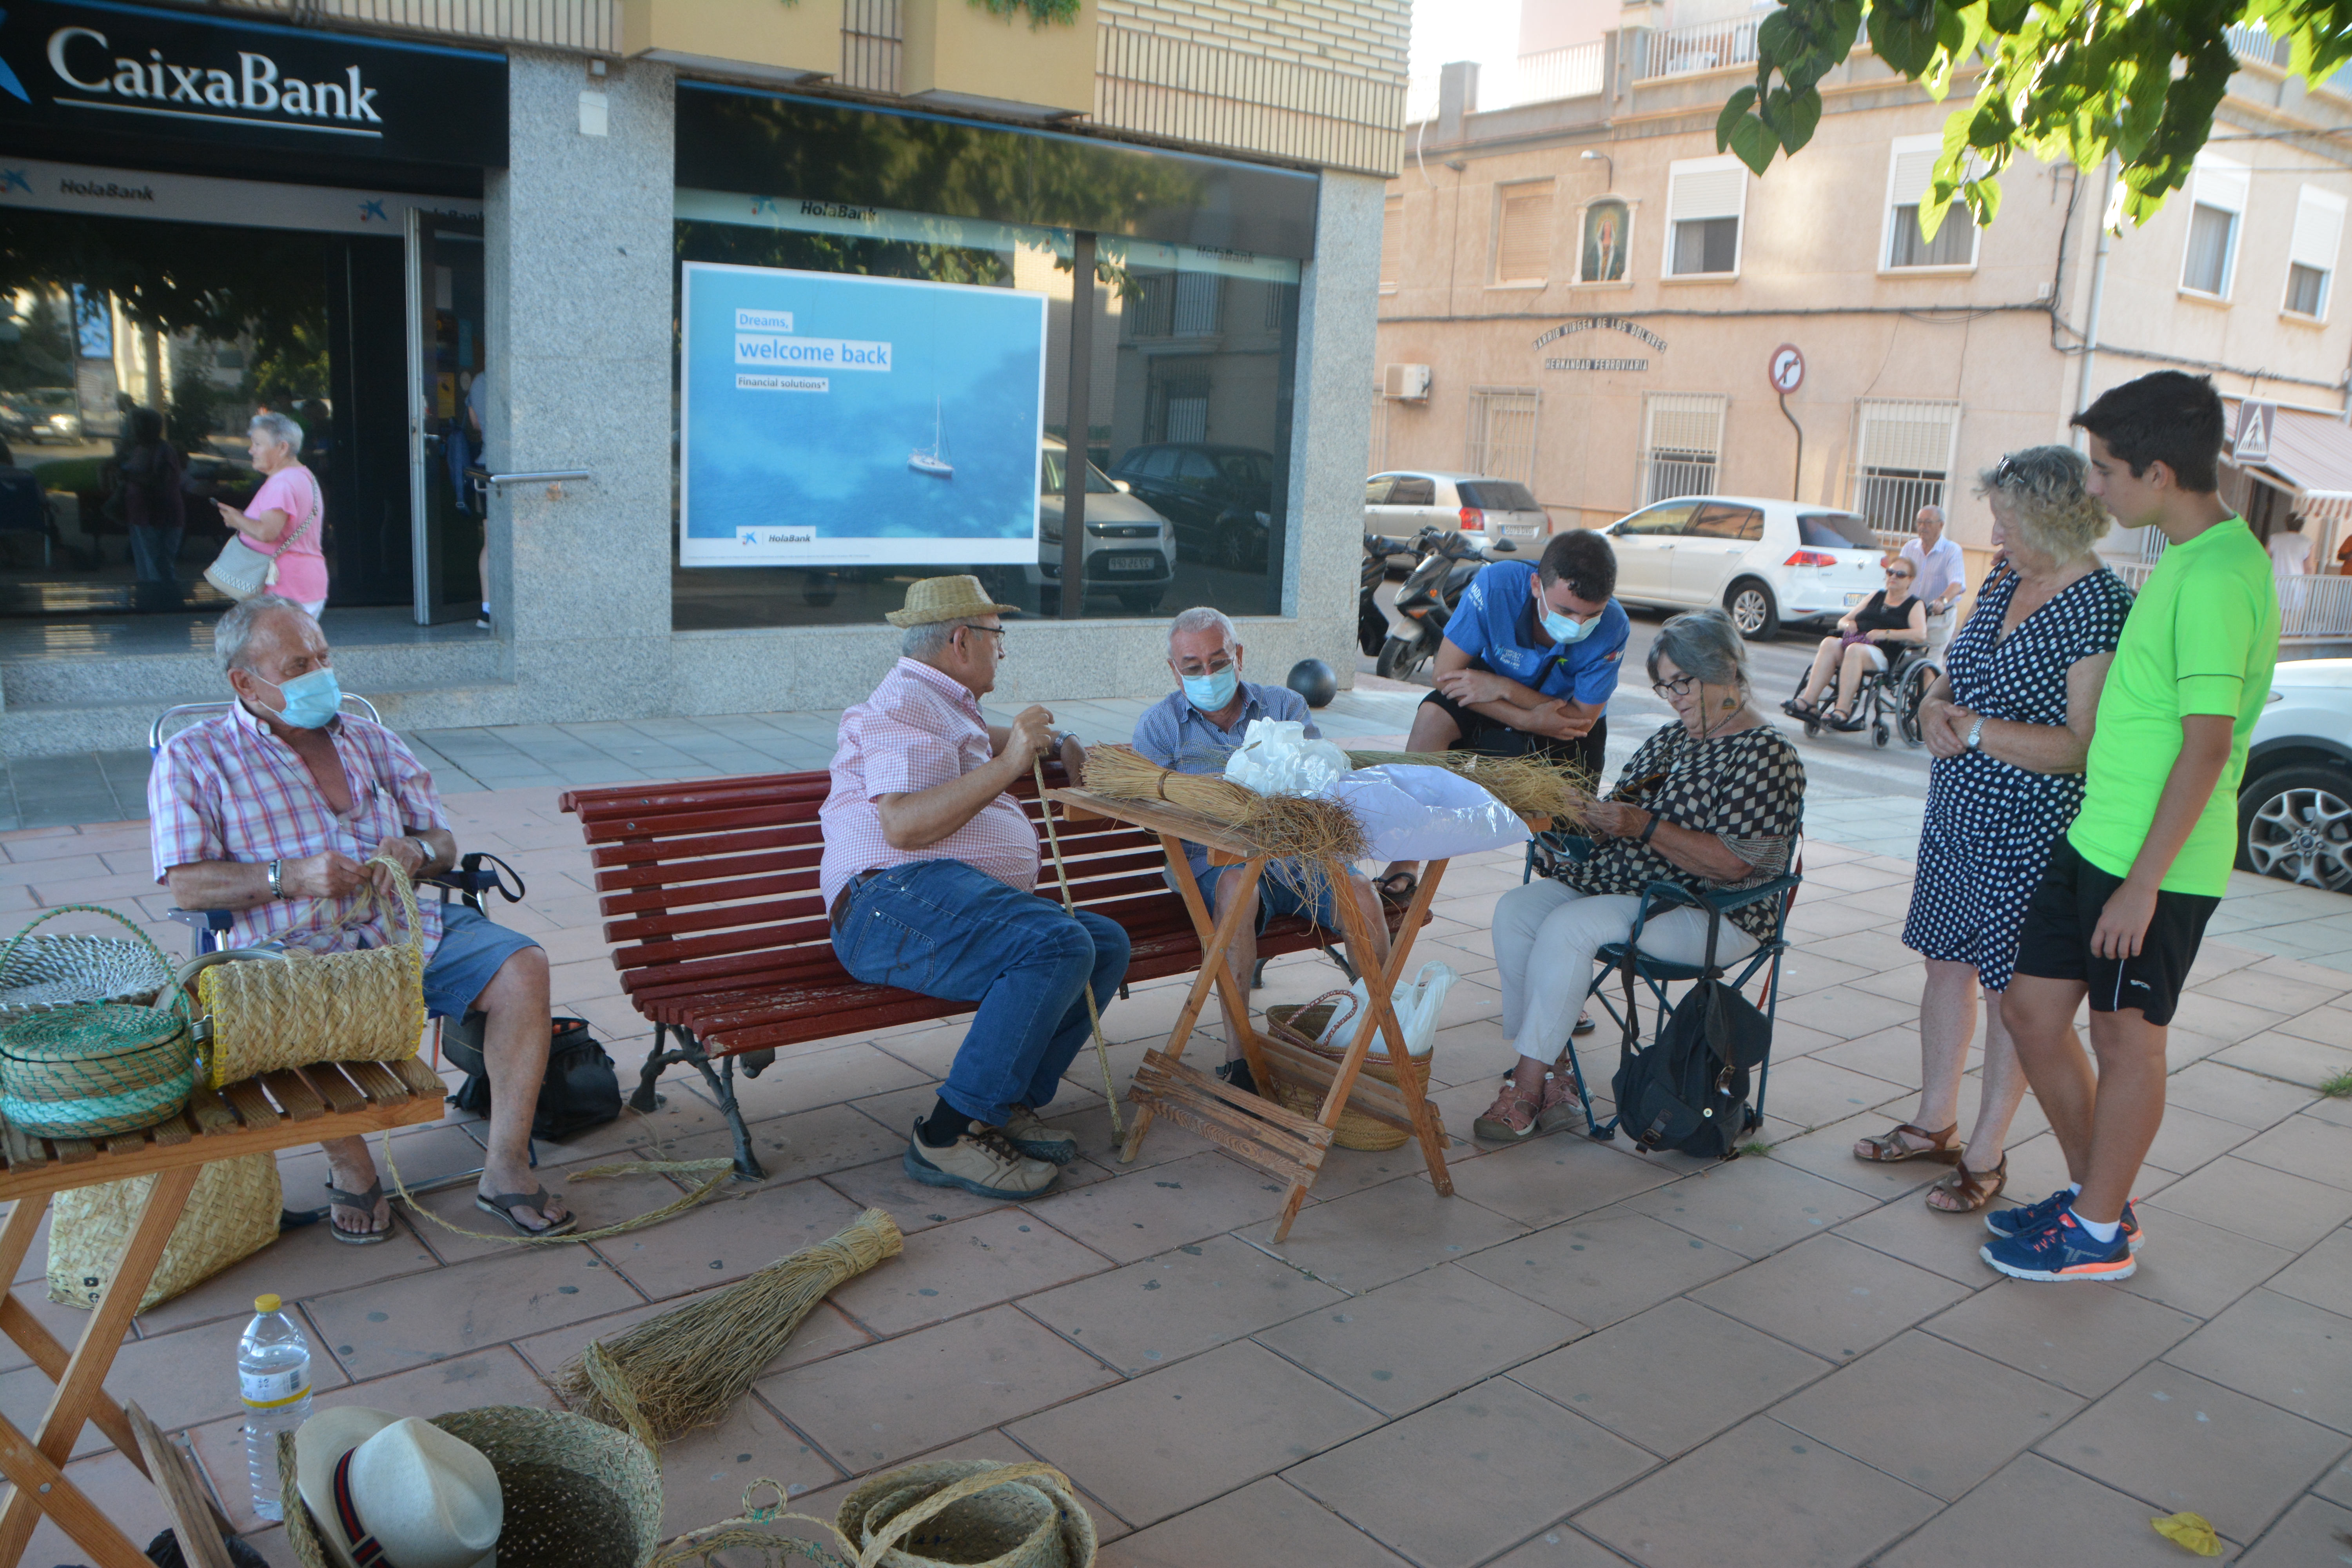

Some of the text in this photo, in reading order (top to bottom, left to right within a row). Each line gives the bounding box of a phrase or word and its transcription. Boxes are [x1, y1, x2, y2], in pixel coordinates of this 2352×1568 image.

[46, 27, 383, 123] CaixaBank
[60, 179, 154, 201] HolaBank
[801, 201, 877, 221] HolaBank
[1196, 246, 1254, 263] HolaBank
[740, 314, 788, 328] Dreams,
[1533, 318, 1667, 353] BARRIO VIRGEN DE LOS DOLORES
[739, 339, 887, 364] welcome back
[1546, 359, 1648, 370] HERMANDAD FERROVIARIA
[739, 377, 778, 387] Financial
